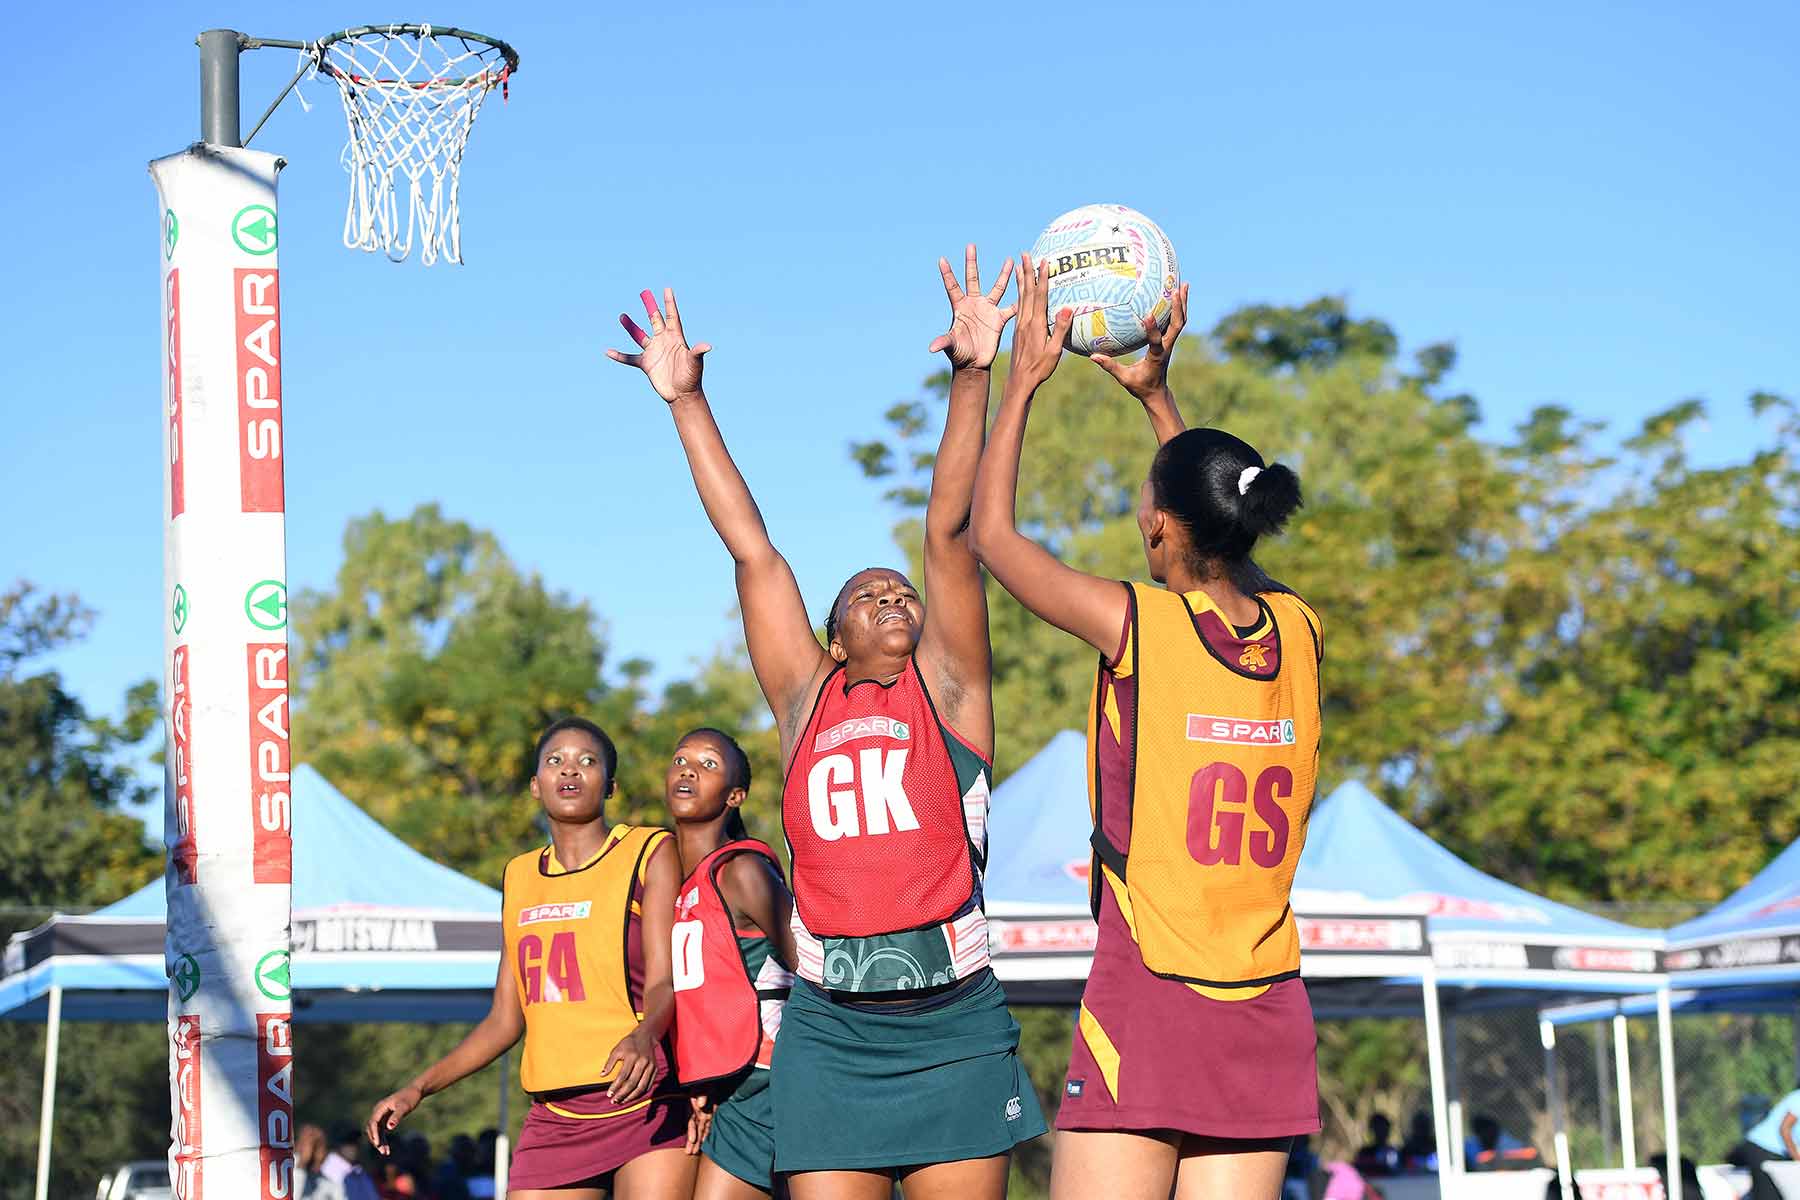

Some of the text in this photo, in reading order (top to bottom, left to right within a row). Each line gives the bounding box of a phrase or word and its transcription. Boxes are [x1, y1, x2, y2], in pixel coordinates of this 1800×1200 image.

[1035, 246, 1127, 286] LBERT
[242, 274, 281, 460] SPAR
[172, 650, 190, 836] SPAR
[255, 647, 291, 832] SPAR
[830, 719, 888, 744] SPAR
[1211, 721, 1281, 741] SPAR
[807, 747, 921, 842] GK
[1186, 761, 1294, 869] GS
[528, 905, 576, 921] SPAR
[518, 931, 587, 1007] GA
[265, 1017, 294, 1200] SPAR
